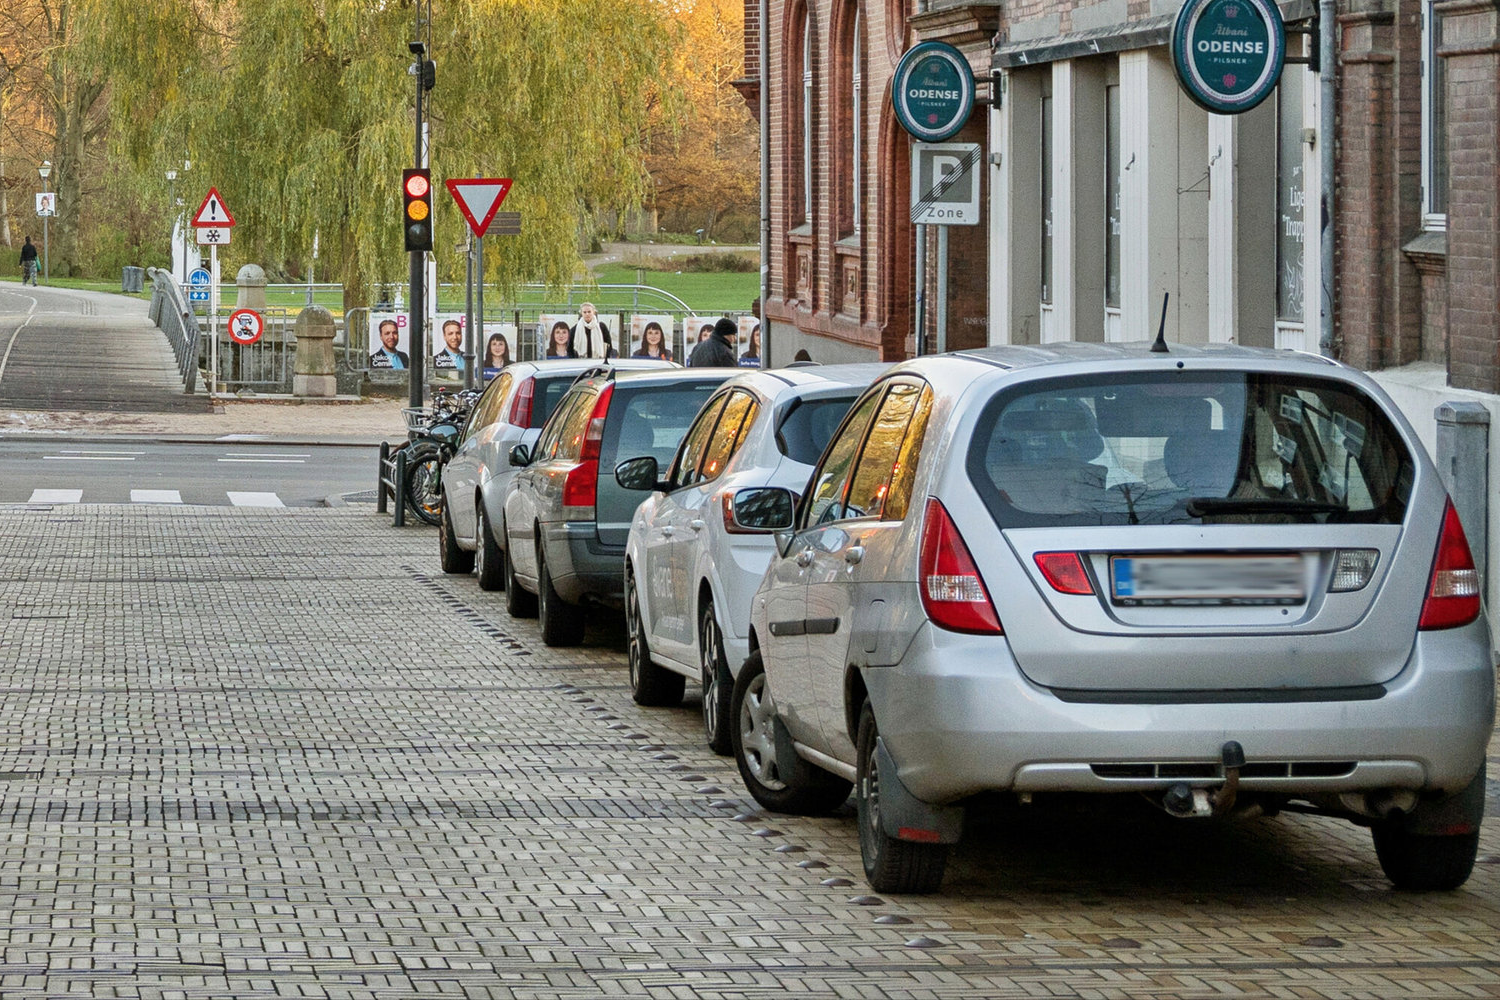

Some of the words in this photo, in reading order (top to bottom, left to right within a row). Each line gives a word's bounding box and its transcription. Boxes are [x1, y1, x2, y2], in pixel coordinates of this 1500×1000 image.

[1197, 40, 1264, 54] ODENSE
[909, 89, 959, 100] ODENSE
[927, 206, 964, 218] Zone
[397, 315, 407, 327] B
